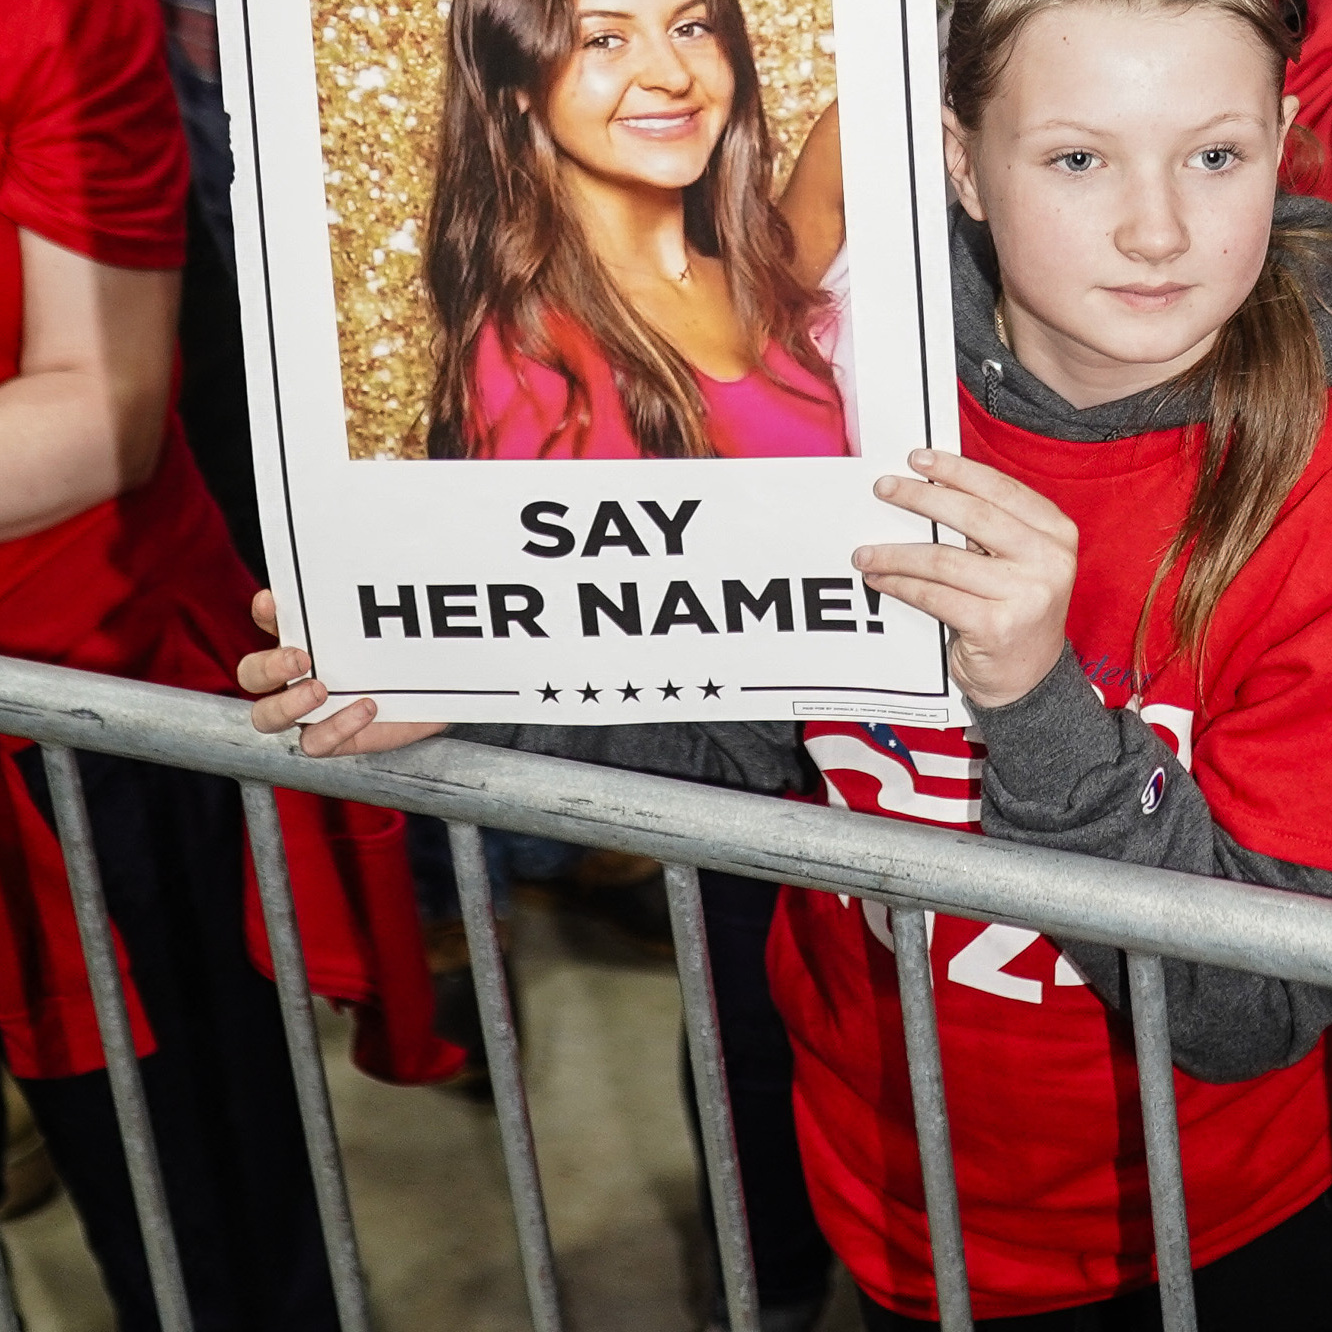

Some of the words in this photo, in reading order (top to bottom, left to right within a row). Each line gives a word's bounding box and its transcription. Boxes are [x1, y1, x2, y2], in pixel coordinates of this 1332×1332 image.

[520, 499, 702, 559] SAY
[357, 583, 550, 639] HER
[576, 577, 885, 637] NAME!
